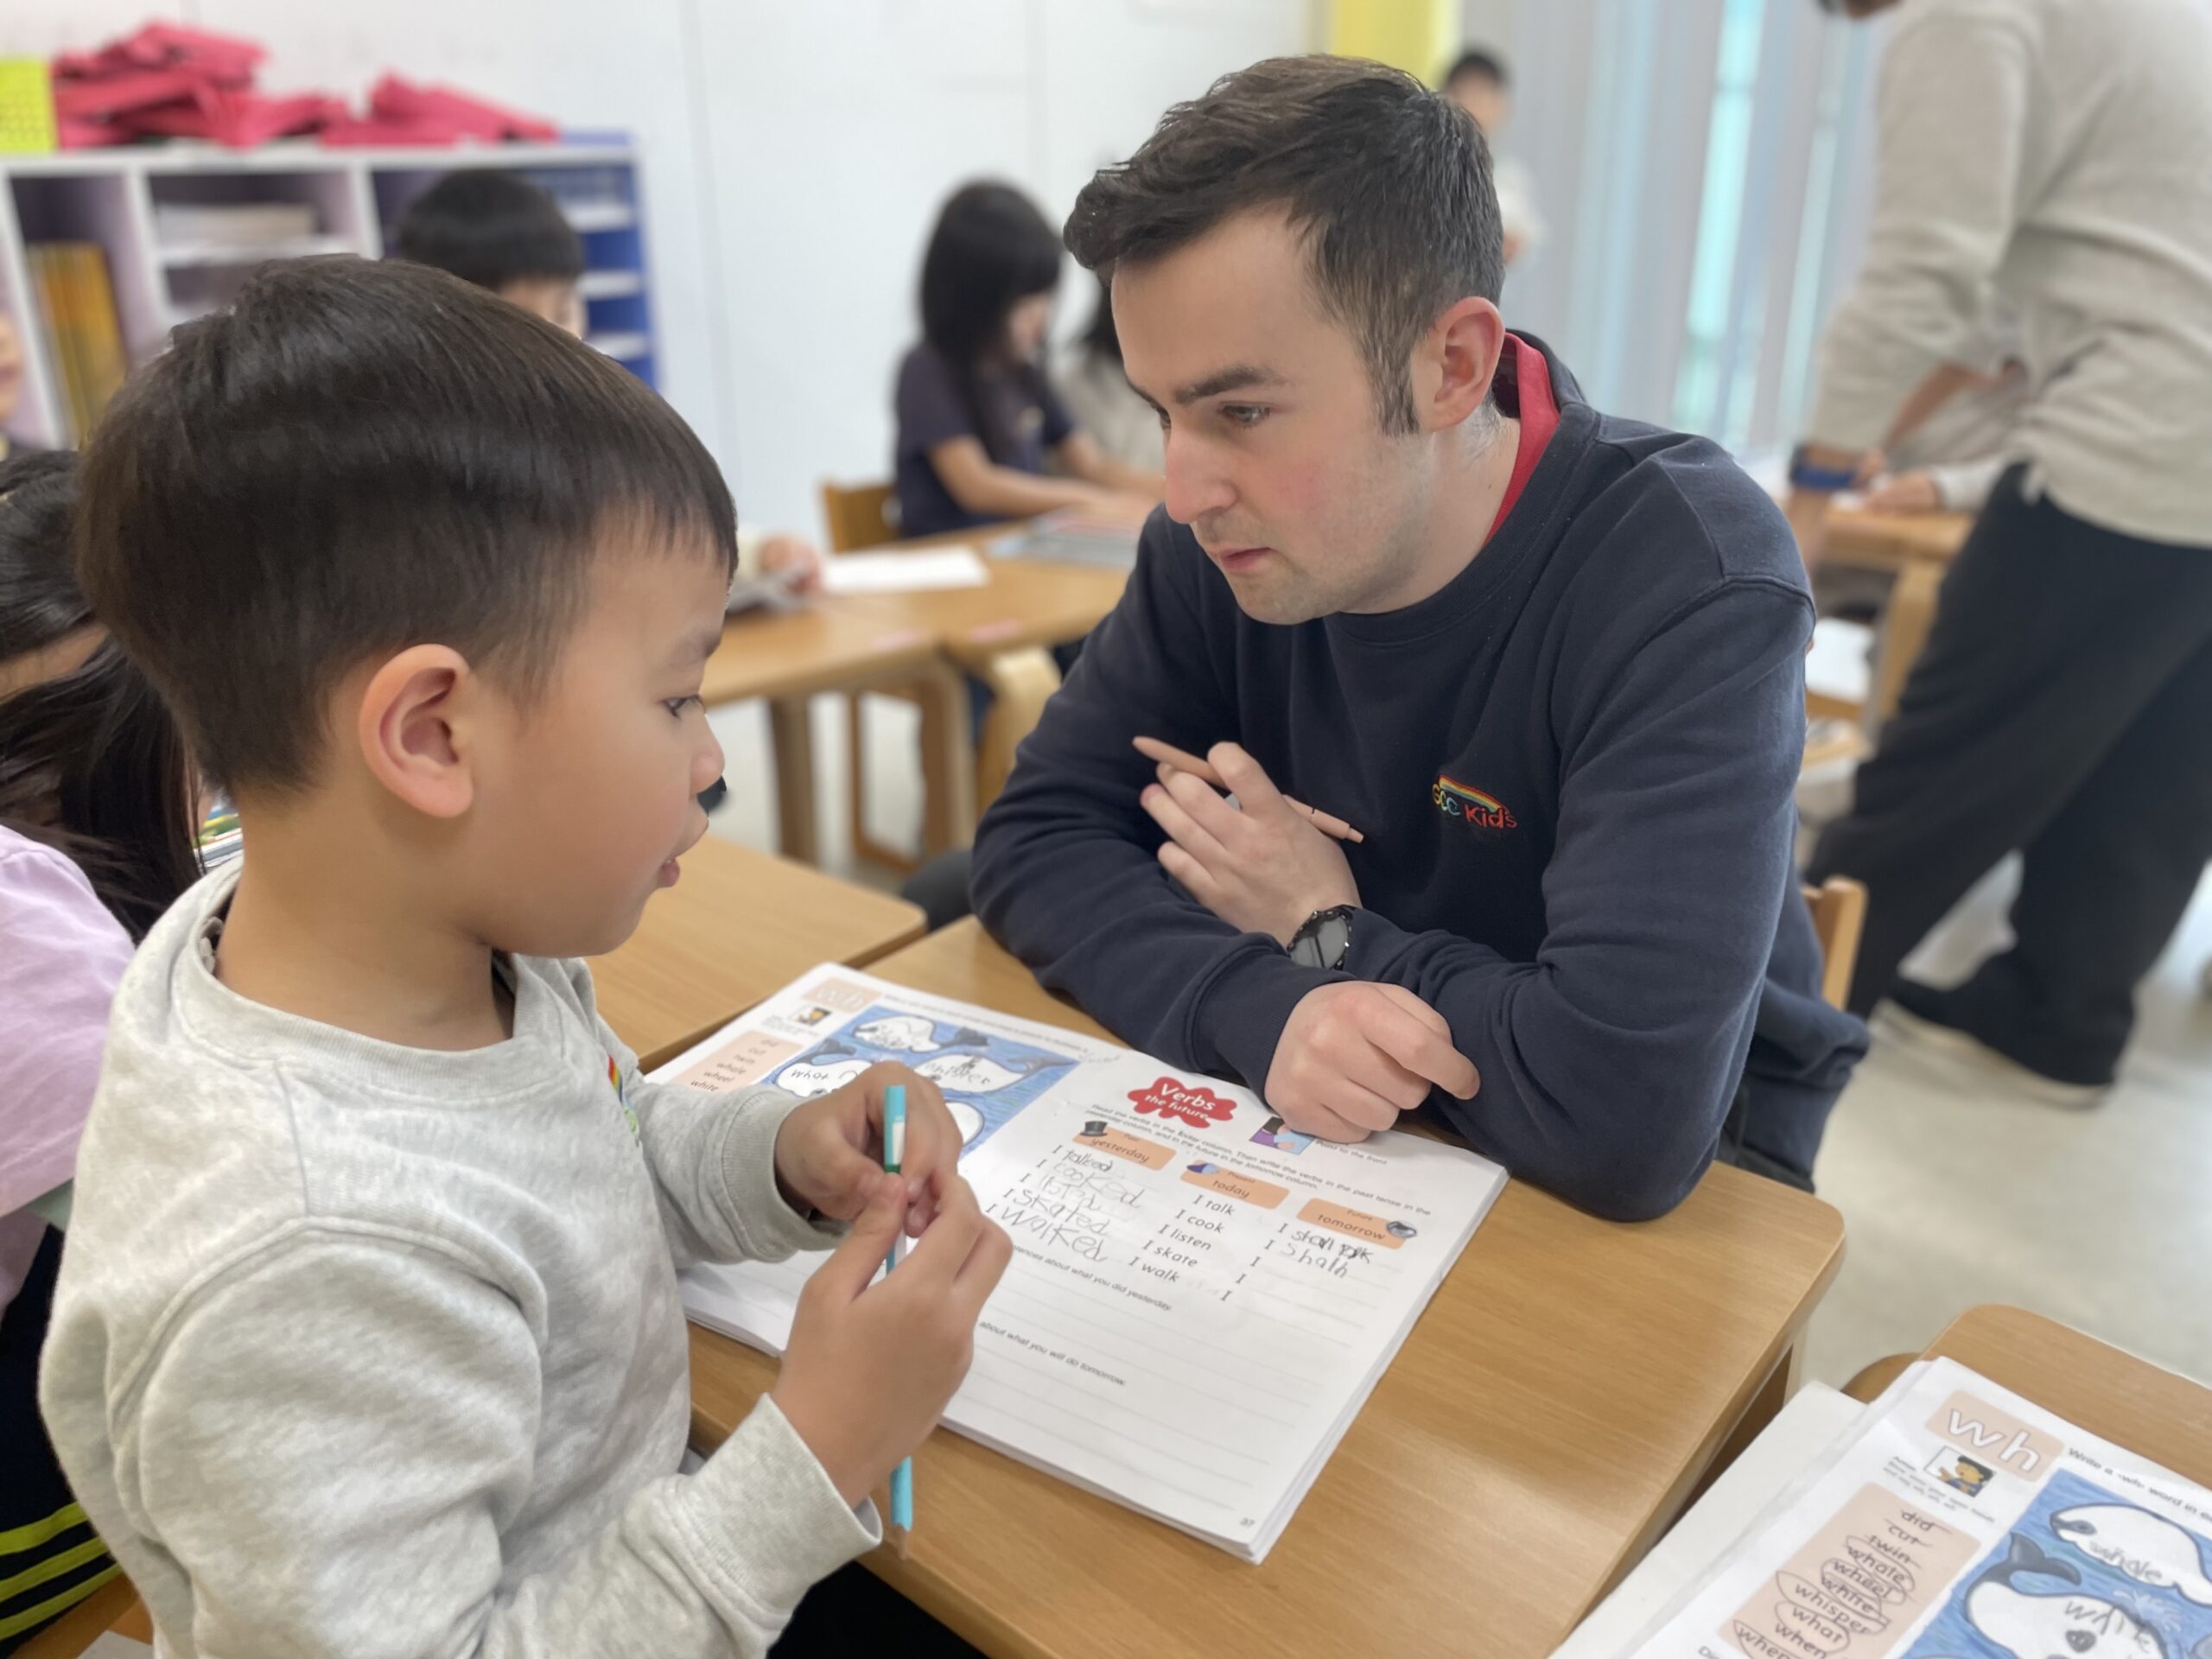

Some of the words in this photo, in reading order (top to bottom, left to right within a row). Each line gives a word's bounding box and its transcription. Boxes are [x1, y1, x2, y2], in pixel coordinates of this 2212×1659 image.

[1465, 803, 1518, 830] Kids
[690, 1079, 720, 1092] white
[1160, 1083, 1217, 1112] Verbs
[1143, 1094, 1166, 1107] the
[1168, 1101, 1210, 1120] future
[1052, 1144, 1063, 1154] I
[1090, 1138, 1151, 1164] yesterday
[1154, 1130, 1170, 1141] and
[1180, 1138, 1194, 1149] the
[1196, 1143, 1220, 1158] future
[1230, 1155, 1243, 1166] the
[1246, 1161, 1285, 1179] tomorrow
[1351, 1150, 1364, 1160] the
[1036, 1159, 1048, 1168] I
[1129, 1114, 1150, 1126] verbs
[1162, 1122, 1176, 1134] the
[1236, 1150, 1258, 1162] Then
[1260, 1159, 1281, 1170] write
[1283, 1165, 1297, 1175] the
[1300, 1170, 1323, 1184] verbs
[1337, 1183, 1351, 1192] the
[1353, 1188, 1374, 1199] past
[1376, 1194, 1402, 1208] tense
[1416, 1206, 1431, 1217] the
[1020, 1173, 1032, 1183] I
[1212, 1179, 1250, 1199] today
[1002, 1188, 1014, 1198] I
[1192, 1193, 1204, 1205] I
[1205, 1198, 1236, 1217] talk
[985, 1204, 998, 1213] I
[1175, 1208, 1187, 1220] I
[1187, 1214, 1226, 1235] cook
[1158, 1224, 1171, 1235] I
[1170, 1228, 1212, 1251] listen
[1279, 1222, 1288, 1234] I
[1317, 1212, 1387, 1241] tomorrow
[1142, 1239, 1154, 1250] I
[1154, 1245, 1198, 1268] skate
[1264, 1239, 1274, 1251] I
[1045, 1257, 1071, 1271] about
[1071, 1267, 1093, 1280] what
[1094, 1276, 1110, 1287] you
[1111, 1282, 1127, 1293] did
[1128, 1255, 1140, 1267] I
[1141, 1262, 1180, 1283] walk
[1250, 1255, 1262, 1268] I
[1236, 1273, 1247, 1285] I
[1220, 1290, 1232, 1302] I
[979, 1320, 1006, 1336] about
[1007, 1332, 1030, 1345] what
[1030, 1343, 1048, 1355] you
[1049, 1350, 1065, 1362] will
[1065, 1356, 1078, 1367] do
[1948, 1408, 2041, 1473] wh
[2069, 1447, 2102, 1470] Write
[2105, 1467, 2113, 1476] a
[2149, 1487, 2183, 1507] word
[2184, 1503, 2197, 1514] in
[1901, 1510, 1935, 1532] did
[1868, 1535, 1911, 1564] twin
[1847, 1546, 1906, 1583] whale
[1833, 1560, 1894, 1599] wheel
[1795, 1583, 1872, 1633] whisper
[1821, 1575, 1875, 1614] white
[1791, 1606, 1844, 1644] what
[1774, 1622, 1827, 1659] when
